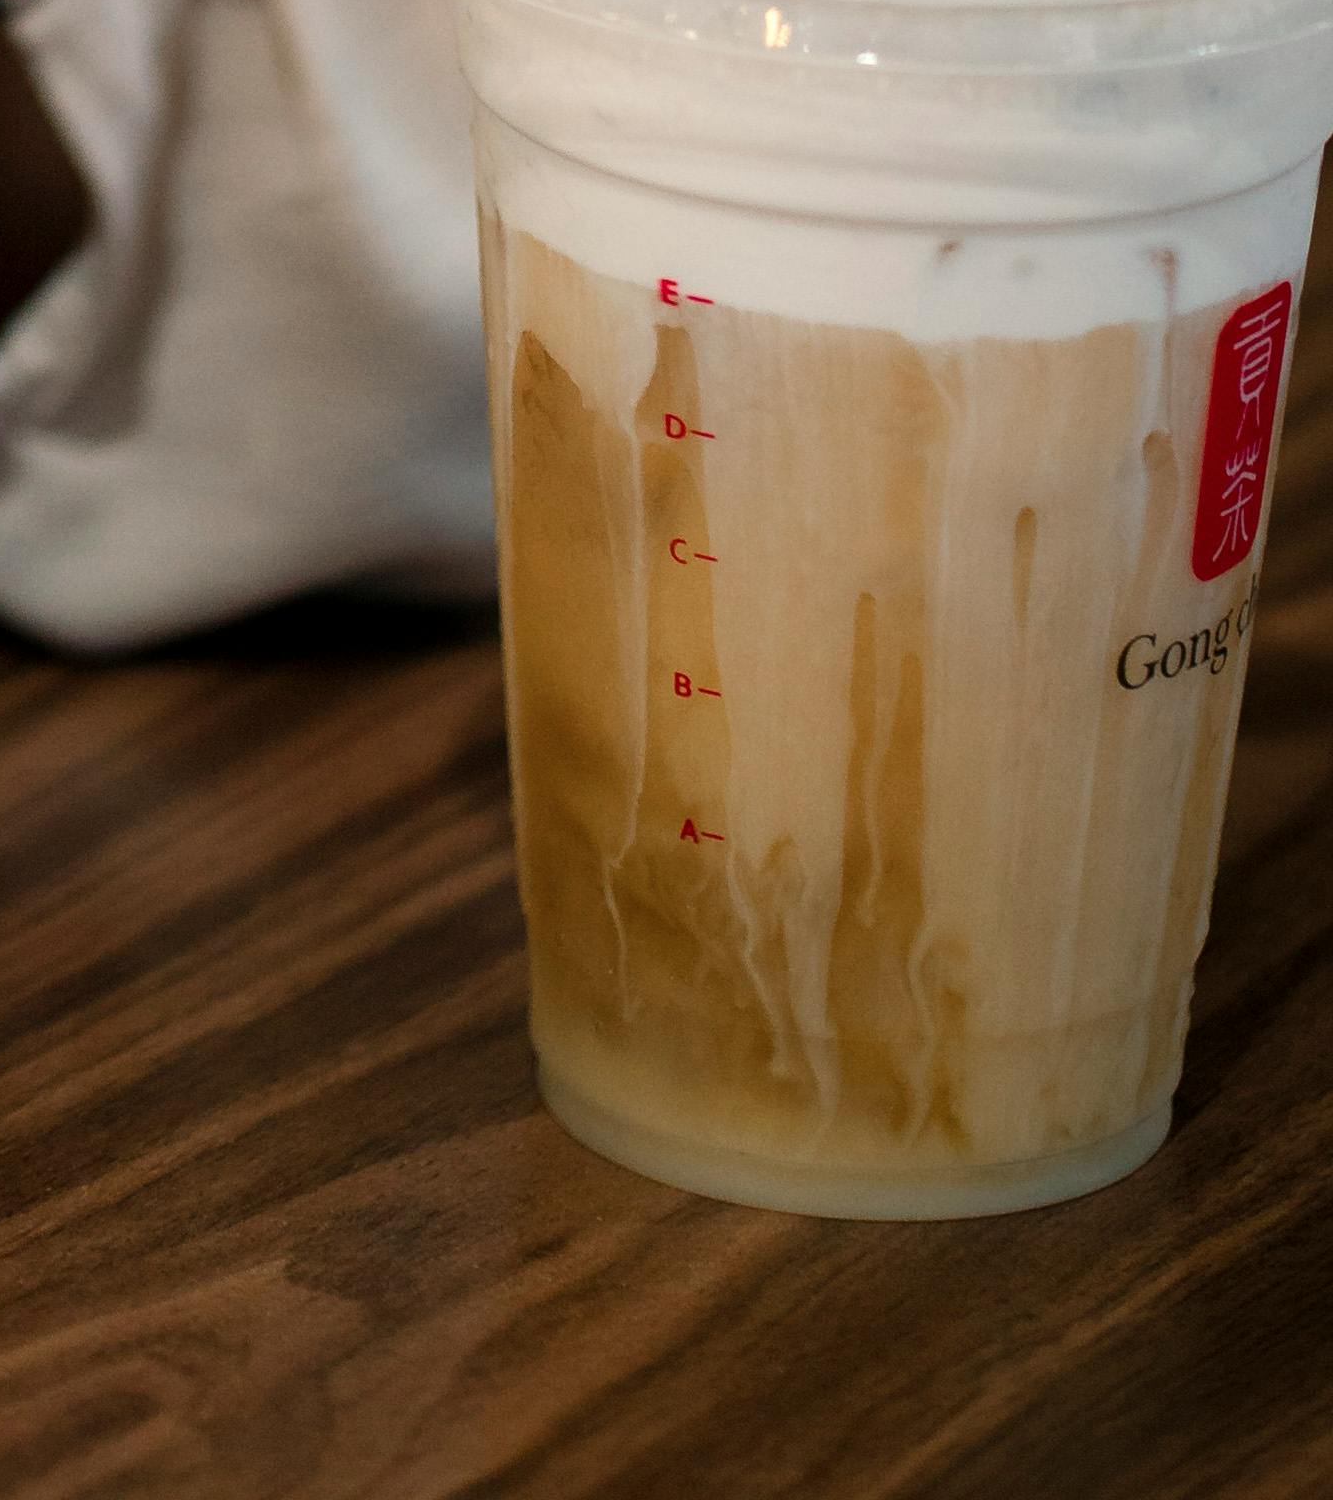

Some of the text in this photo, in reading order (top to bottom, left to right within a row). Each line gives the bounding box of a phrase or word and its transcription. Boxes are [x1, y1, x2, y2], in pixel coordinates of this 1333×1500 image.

[658, 279, 679, 306] E
[664, 414, 686, 439] D
[670, 538, 688, 564] C
[1116, 607, 1234, 690] Gong
[674, 673, 693, 698] B
[680, 818, 700, 843] A
